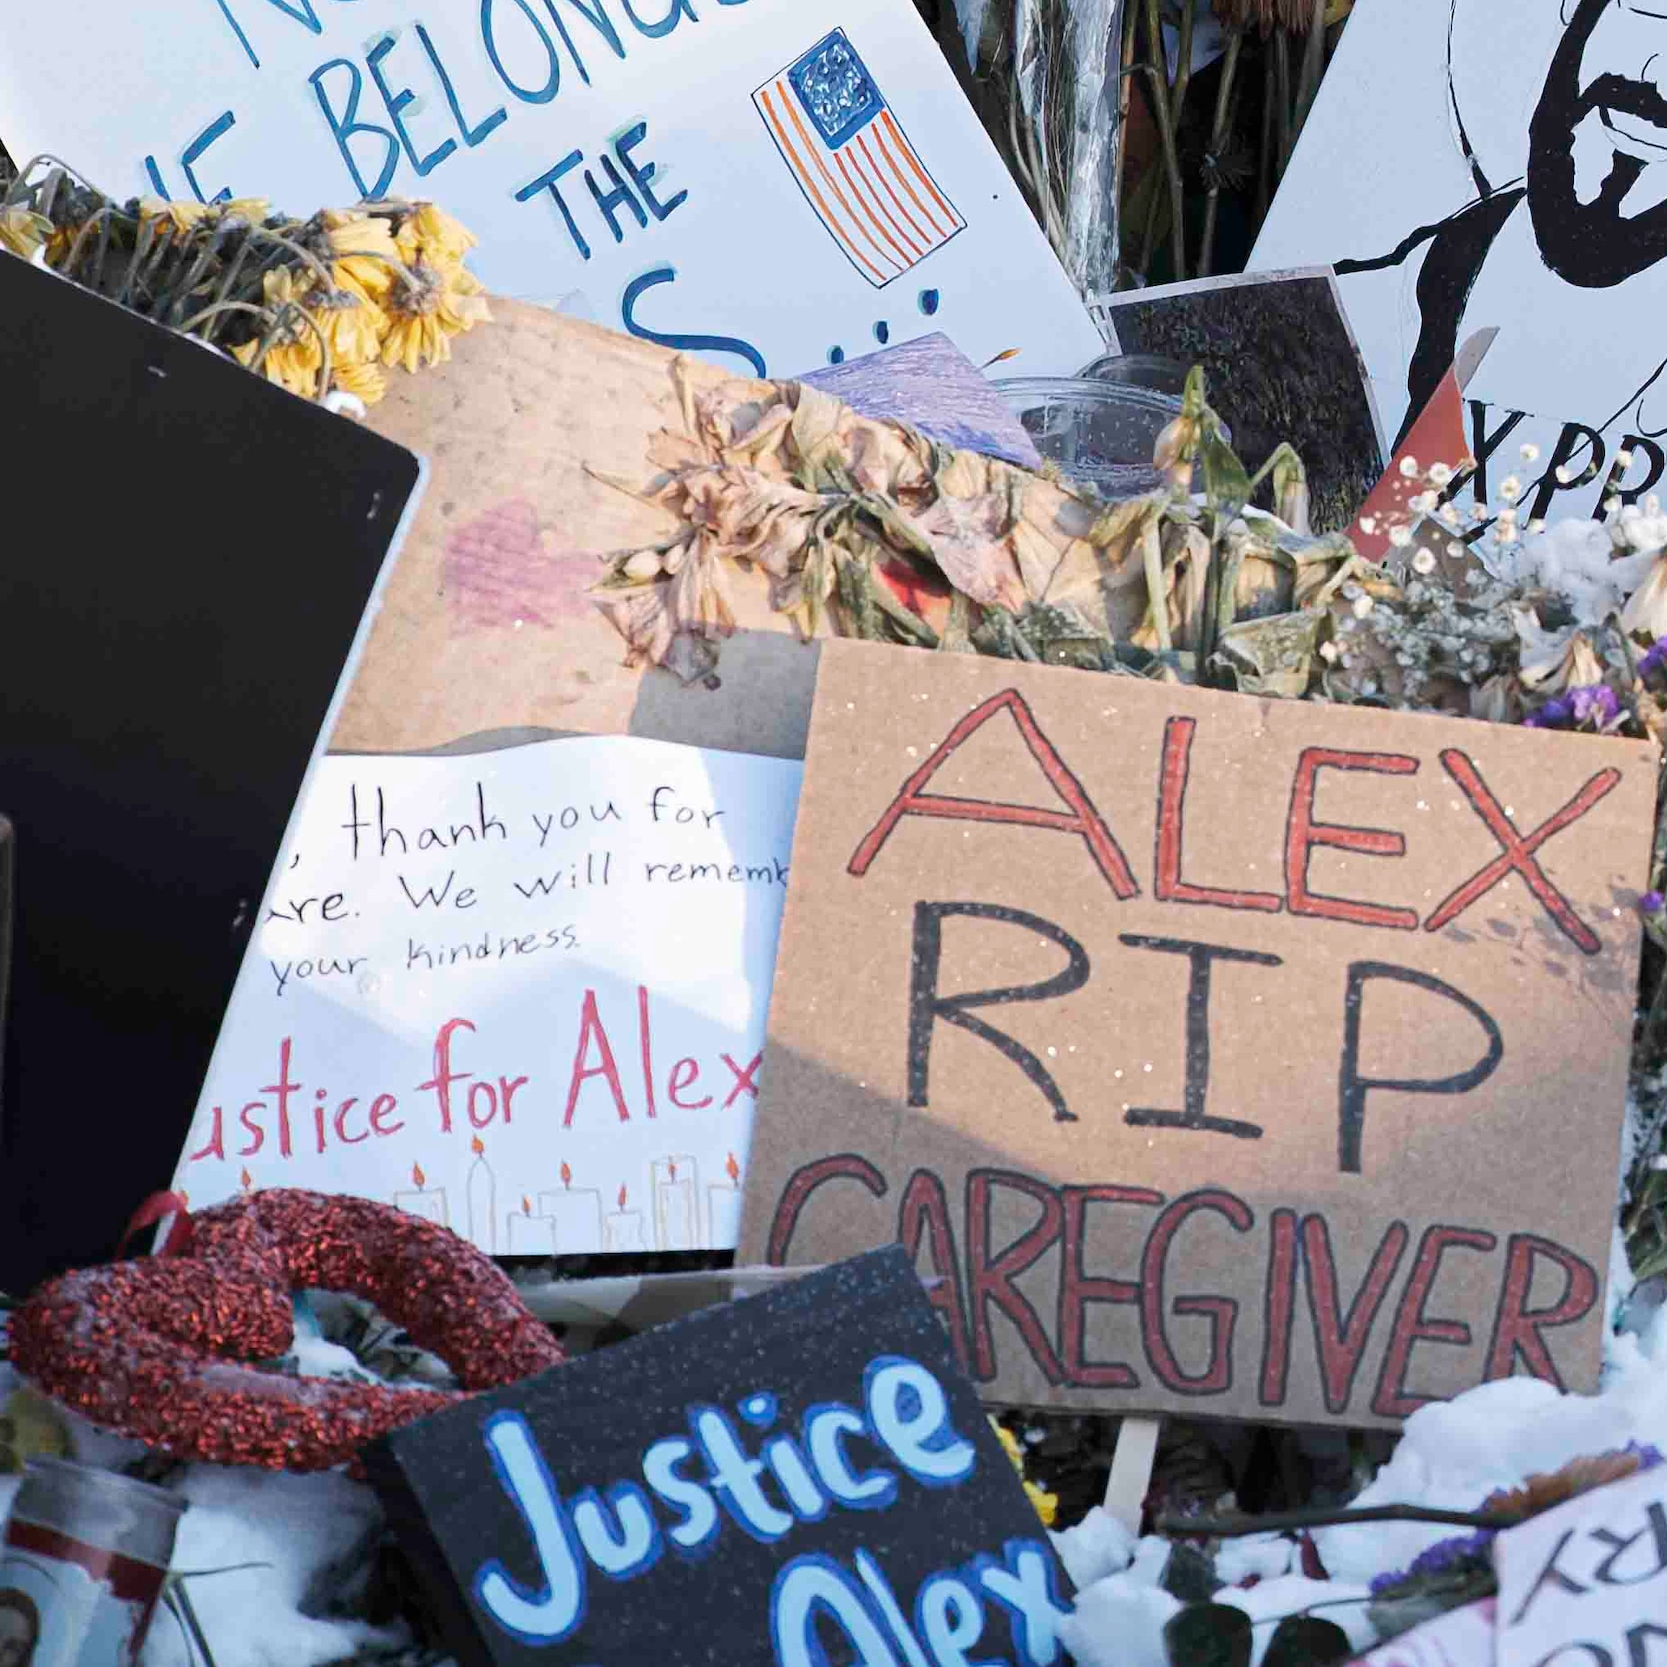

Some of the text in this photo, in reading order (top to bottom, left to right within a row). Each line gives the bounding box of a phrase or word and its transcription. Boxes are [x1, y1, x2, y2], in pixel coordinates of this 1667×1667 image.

[513, 119, 689, 261] THE
[341, 781, 727, 861] thank you for
[397, 870, 479, 911] We
[514, 850, 612, 901] will
[847, 686, 1623, 954] ALEX
[269, 923, 581, 997] your kindness.
[414, 1016, 529, 1133] for
[562, 983, 764, 1129] Alex
[904, 897, 1506, 1175] RIP
[766, 1153, 1600, 1417] CAREGIVER
[473, 1353, 981, 1652] Justice
[770, 1534, 1078, 1667] Alex
